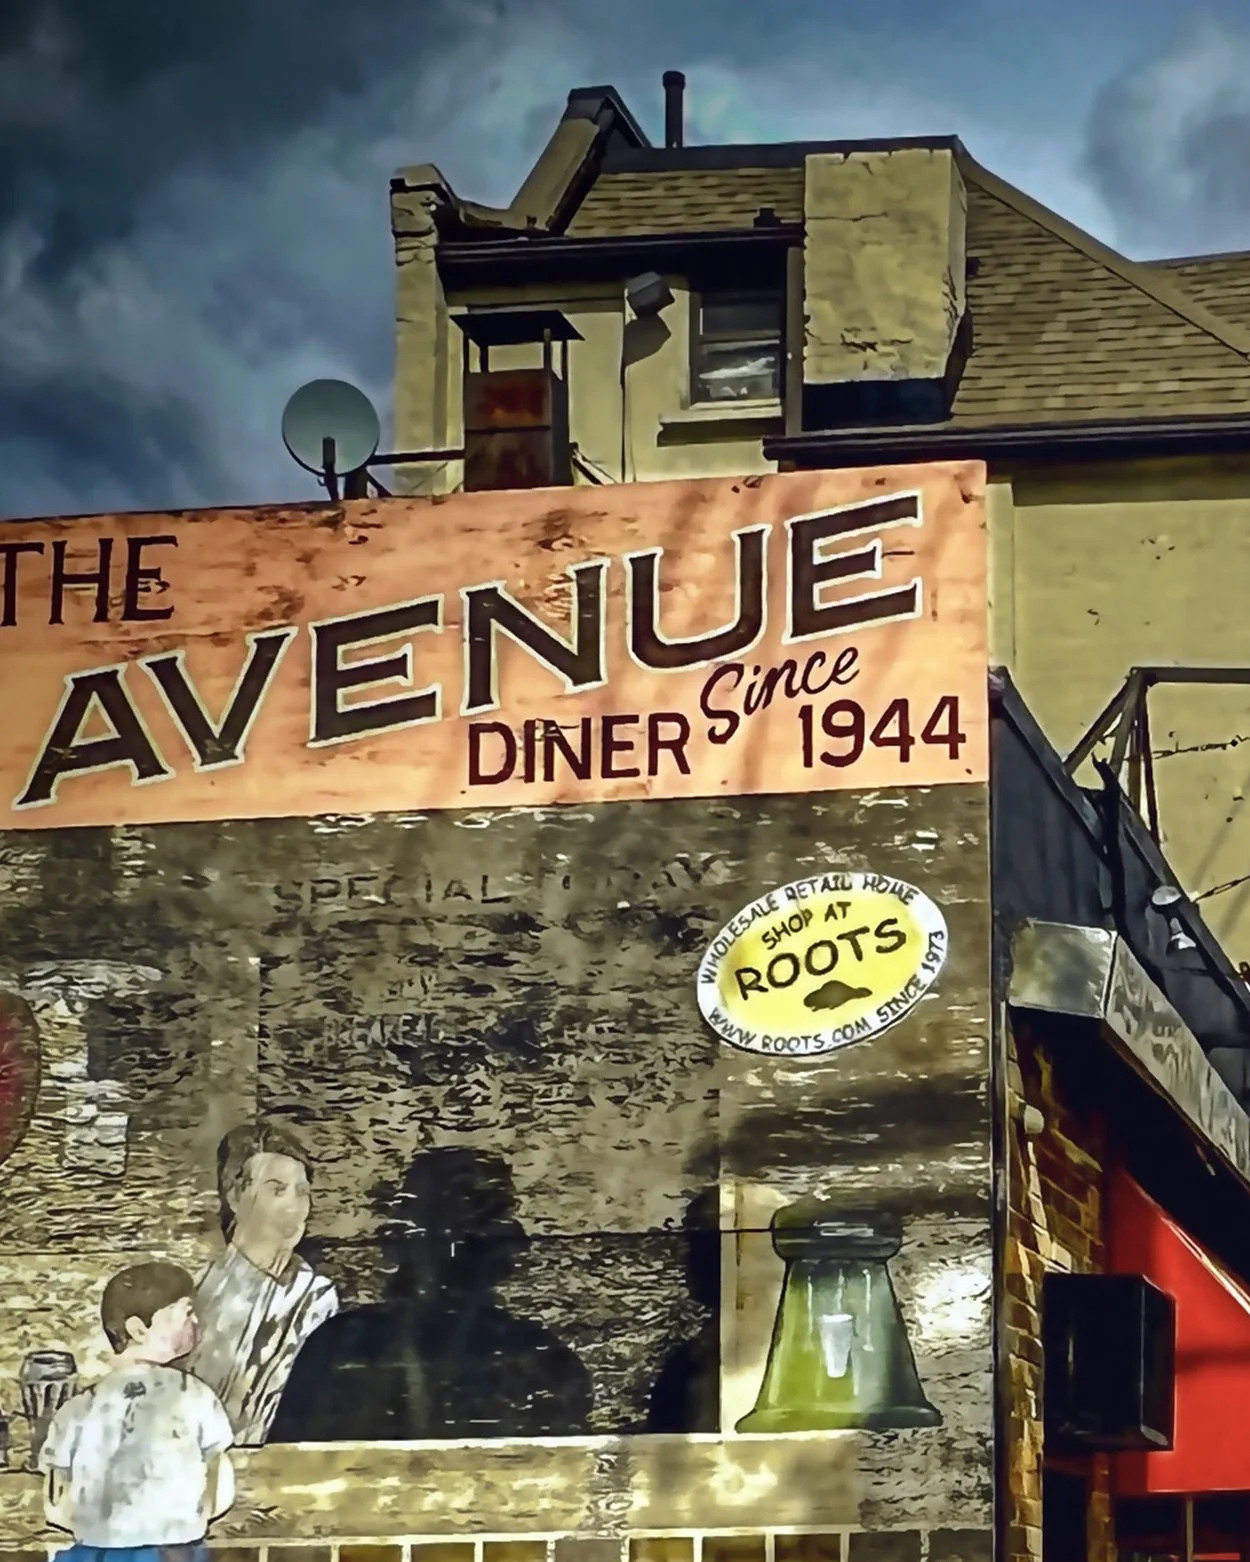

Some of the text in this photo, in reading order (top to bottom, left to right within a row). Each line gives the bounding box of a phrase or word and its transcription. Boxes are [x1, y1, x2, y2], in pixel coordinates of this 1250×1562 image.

[0, 535, 179, 628] THE
[12, 490, 923, 809] AVENUE
[467, 646, 967, 786] DINER Since 1944
[700, 874, 920, 984] WHOLESALE RETAIL HOME
[735, 918, 907, 1000] ROOTS
[762, 901, 852, 950] SHOP AT
[876, 974, 928, 1024] SINCE
